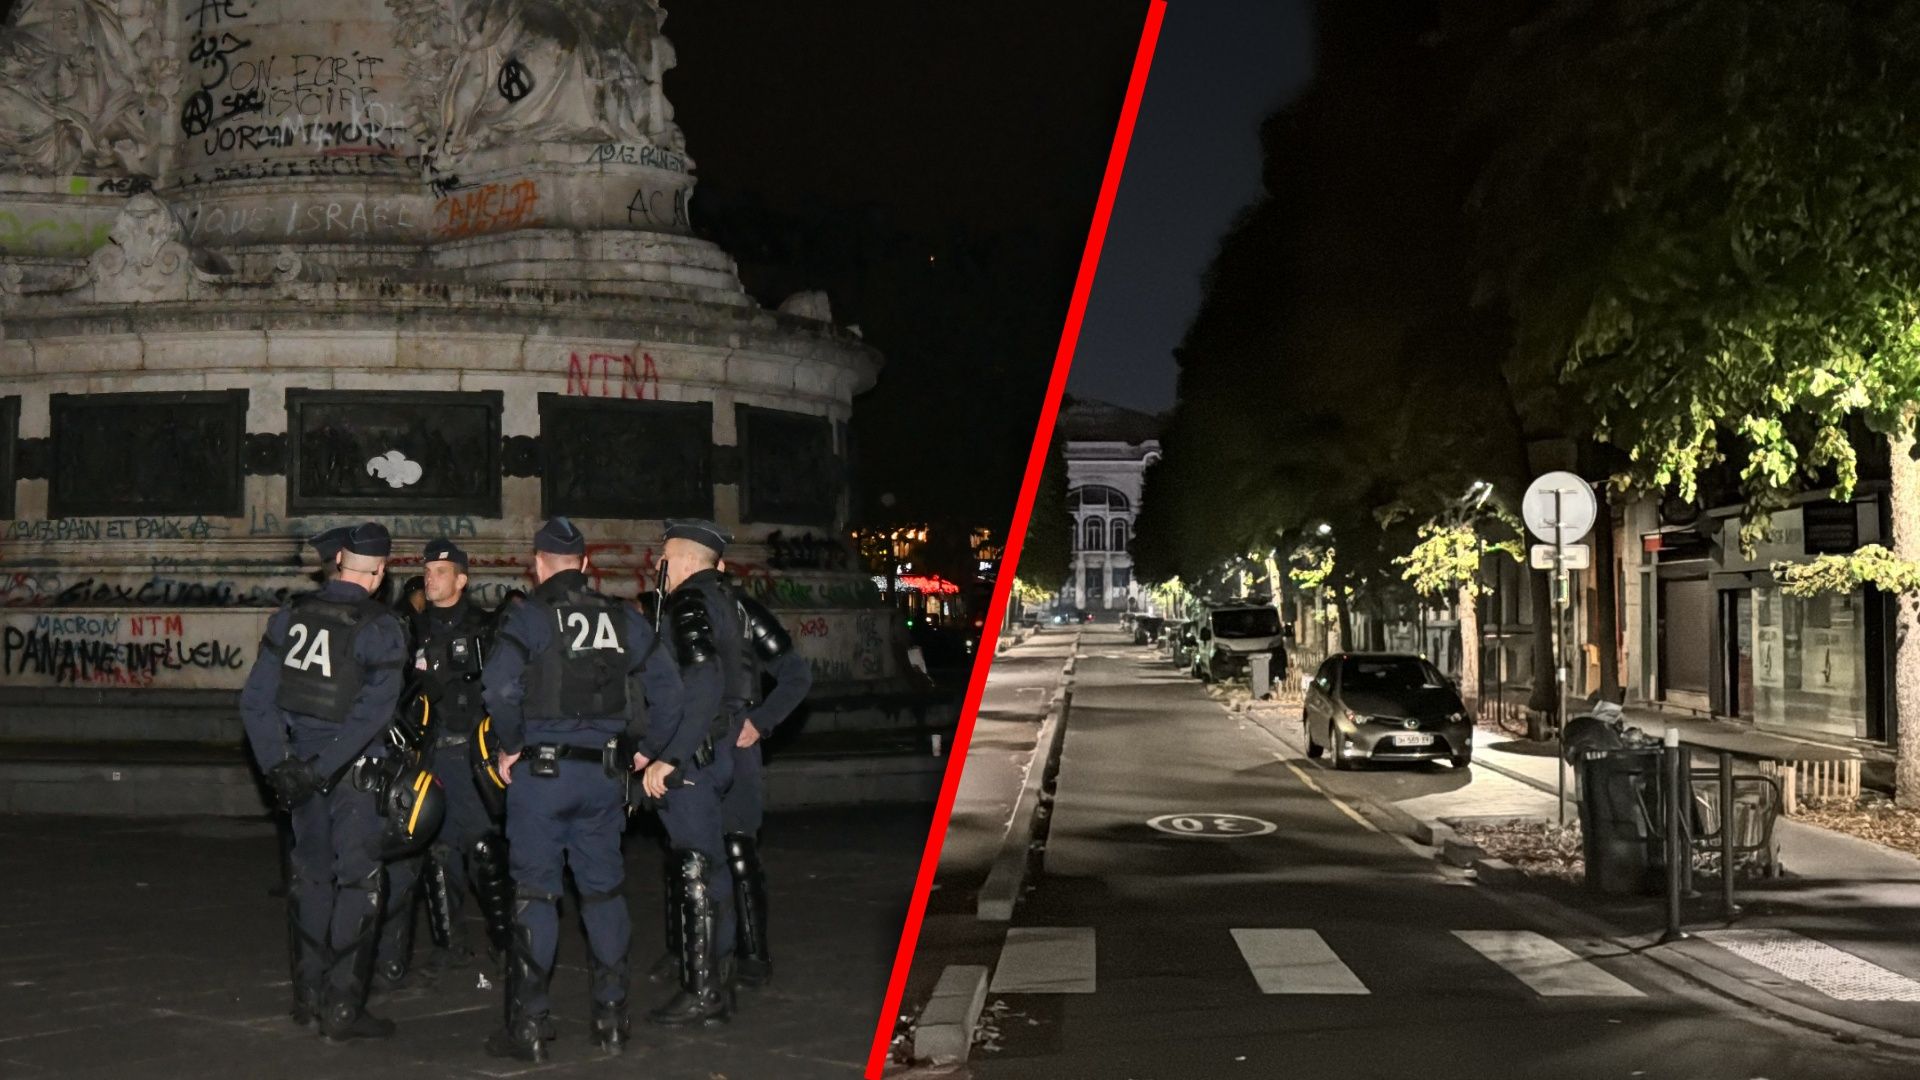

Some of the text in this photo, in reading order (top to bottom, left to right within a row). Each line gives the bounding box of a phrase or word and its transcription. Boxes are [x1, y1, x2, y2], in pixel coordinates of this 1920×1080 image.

[230, 55, 277, 91] ON
[57, 517, 100, 539] PAIN
[106, 519, 134, 537] ET
[34, 614, 184, 637] MACRON NTM
[566, 612, 620, 652] 2A
[283, 623, 332, 678] 2A
[1171, 816, 1245, 833] 30
